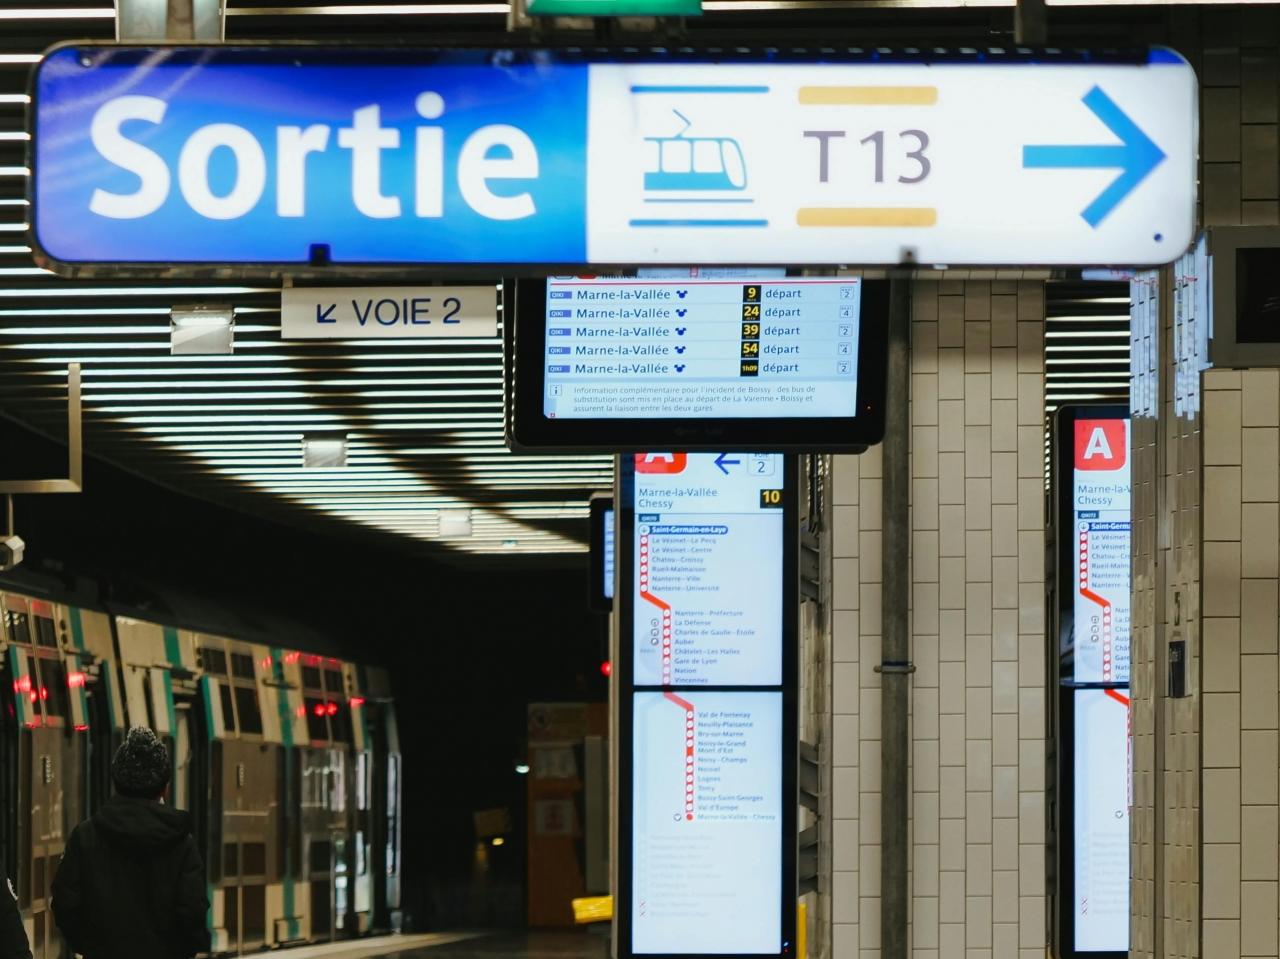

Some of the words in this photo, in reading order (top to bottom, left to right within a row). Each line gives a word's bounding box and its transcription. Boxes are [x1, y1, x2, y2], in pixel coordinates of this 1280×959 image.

[89, 91, 538, 221] Sortie
[577, 290, 670, 300] Marne-la-Vallée
[748, 288, 756, 298] 9
[765, 289, 801, 300] départ
[352, 298, 431, 326] VOIE
[442, 297, 461, 324] 2
[576, 308, 670, 318] Marne-la-Vallée
[744, 306, 759, 317] 24
[765, 308, 800, 318] départ
[576, 327, 669, 336] Marne-la-Vallée
[744, 324, 759, 335] 39
[764, 326, 800, 336] départ
[576, 346, 669, 355] Marne-la-Vallée
[743, 343, 758, 353] 54
[764, 345, 800, 355] départ
[575, 364, 668, 374] Marne-la-Vallée
[763, 364, 798, 373] départ
[664, 396, 683, 404] place
[696, 396, 720, 404] départ
[1083, 427, 1113, 460] A
[758, 462, 765, 473] 2
[639, 487, 718, 498] Marne-la-Vallée
[639, 498, 673, 510] Chessy
[762, 490, 780, 502] 10
[1078, 496, 1112, 506] Chessy
